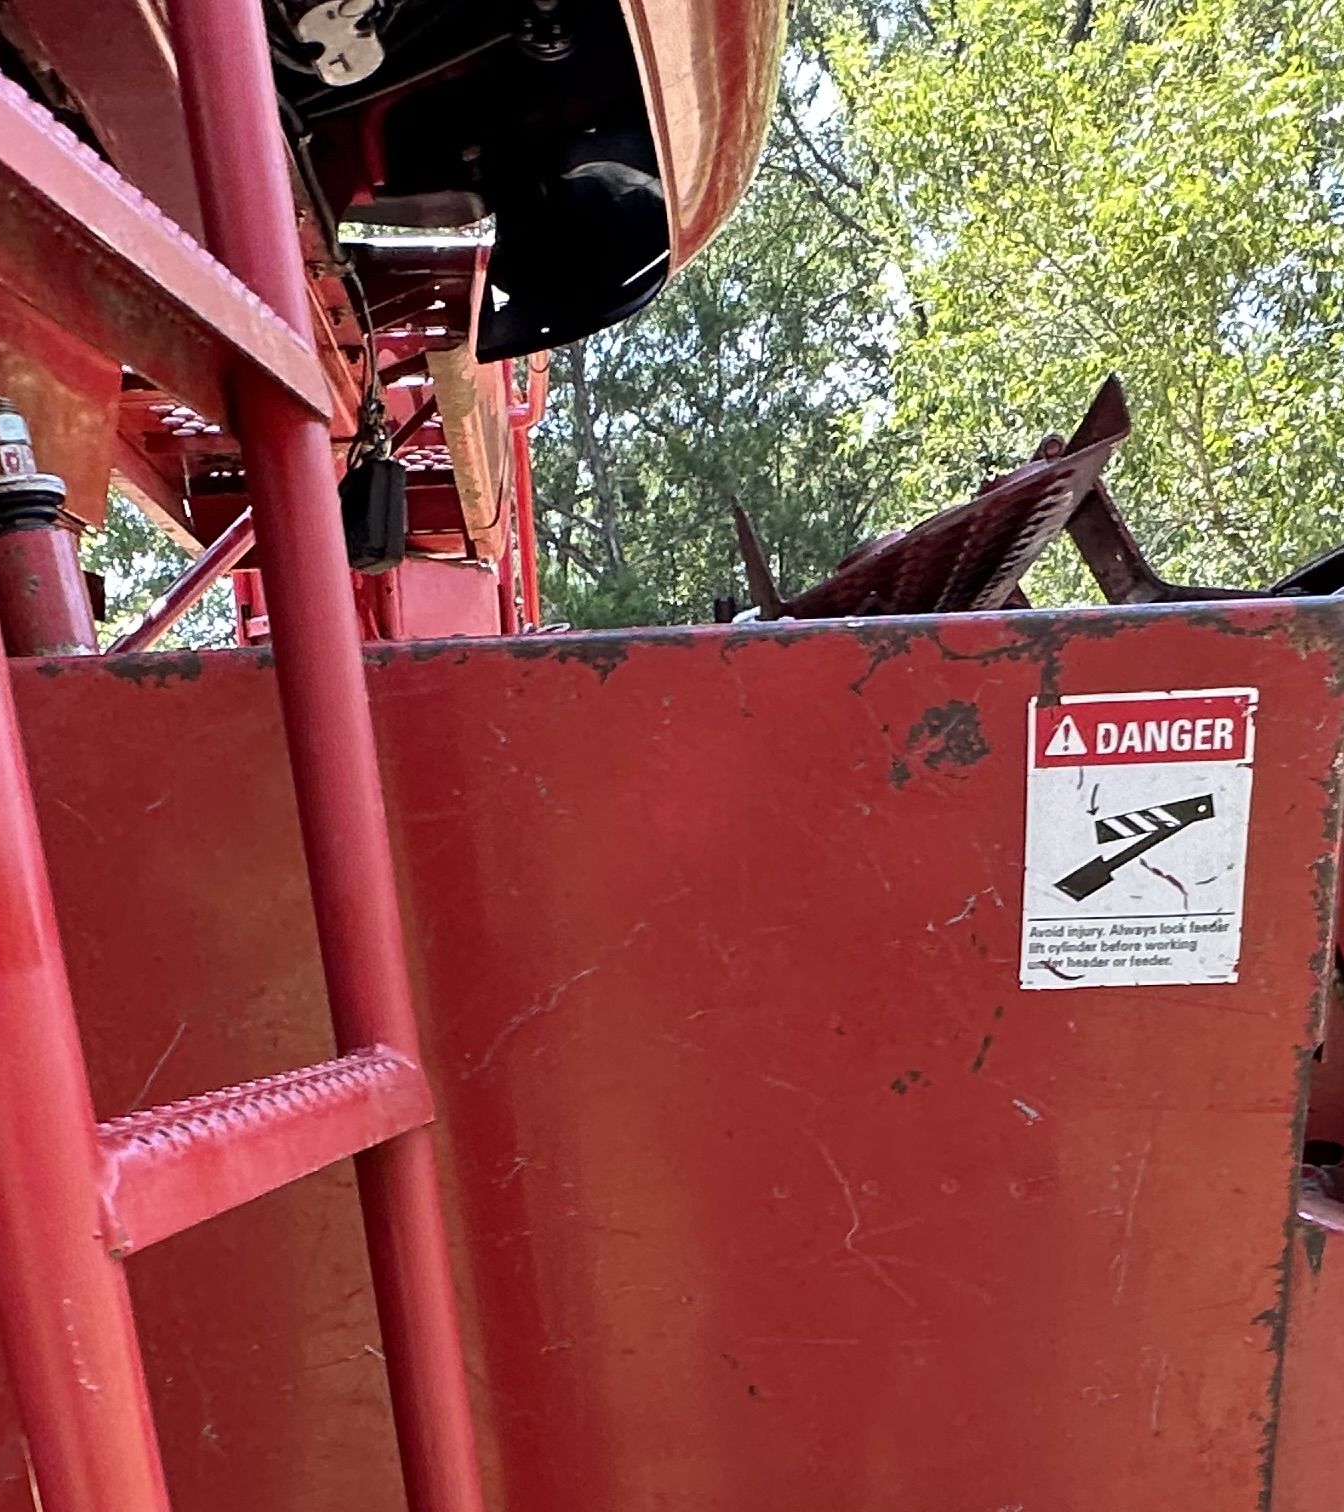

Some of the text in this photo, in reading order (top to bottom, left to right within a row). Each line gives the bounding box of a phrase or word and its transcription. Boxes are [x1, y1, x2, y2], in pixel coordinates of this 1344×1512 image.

[1095, 718, 1234, 754] DANGER
[1029, 921, 1230, 939] Avoid injury. Always lock feeder
[1028, 939, 1197, 954] lift cylinder before working
[1067, 957, 1110, 967] header
[1113, 959, 1127, 967] or
[1129, 955, 1172, 967] feeder.
